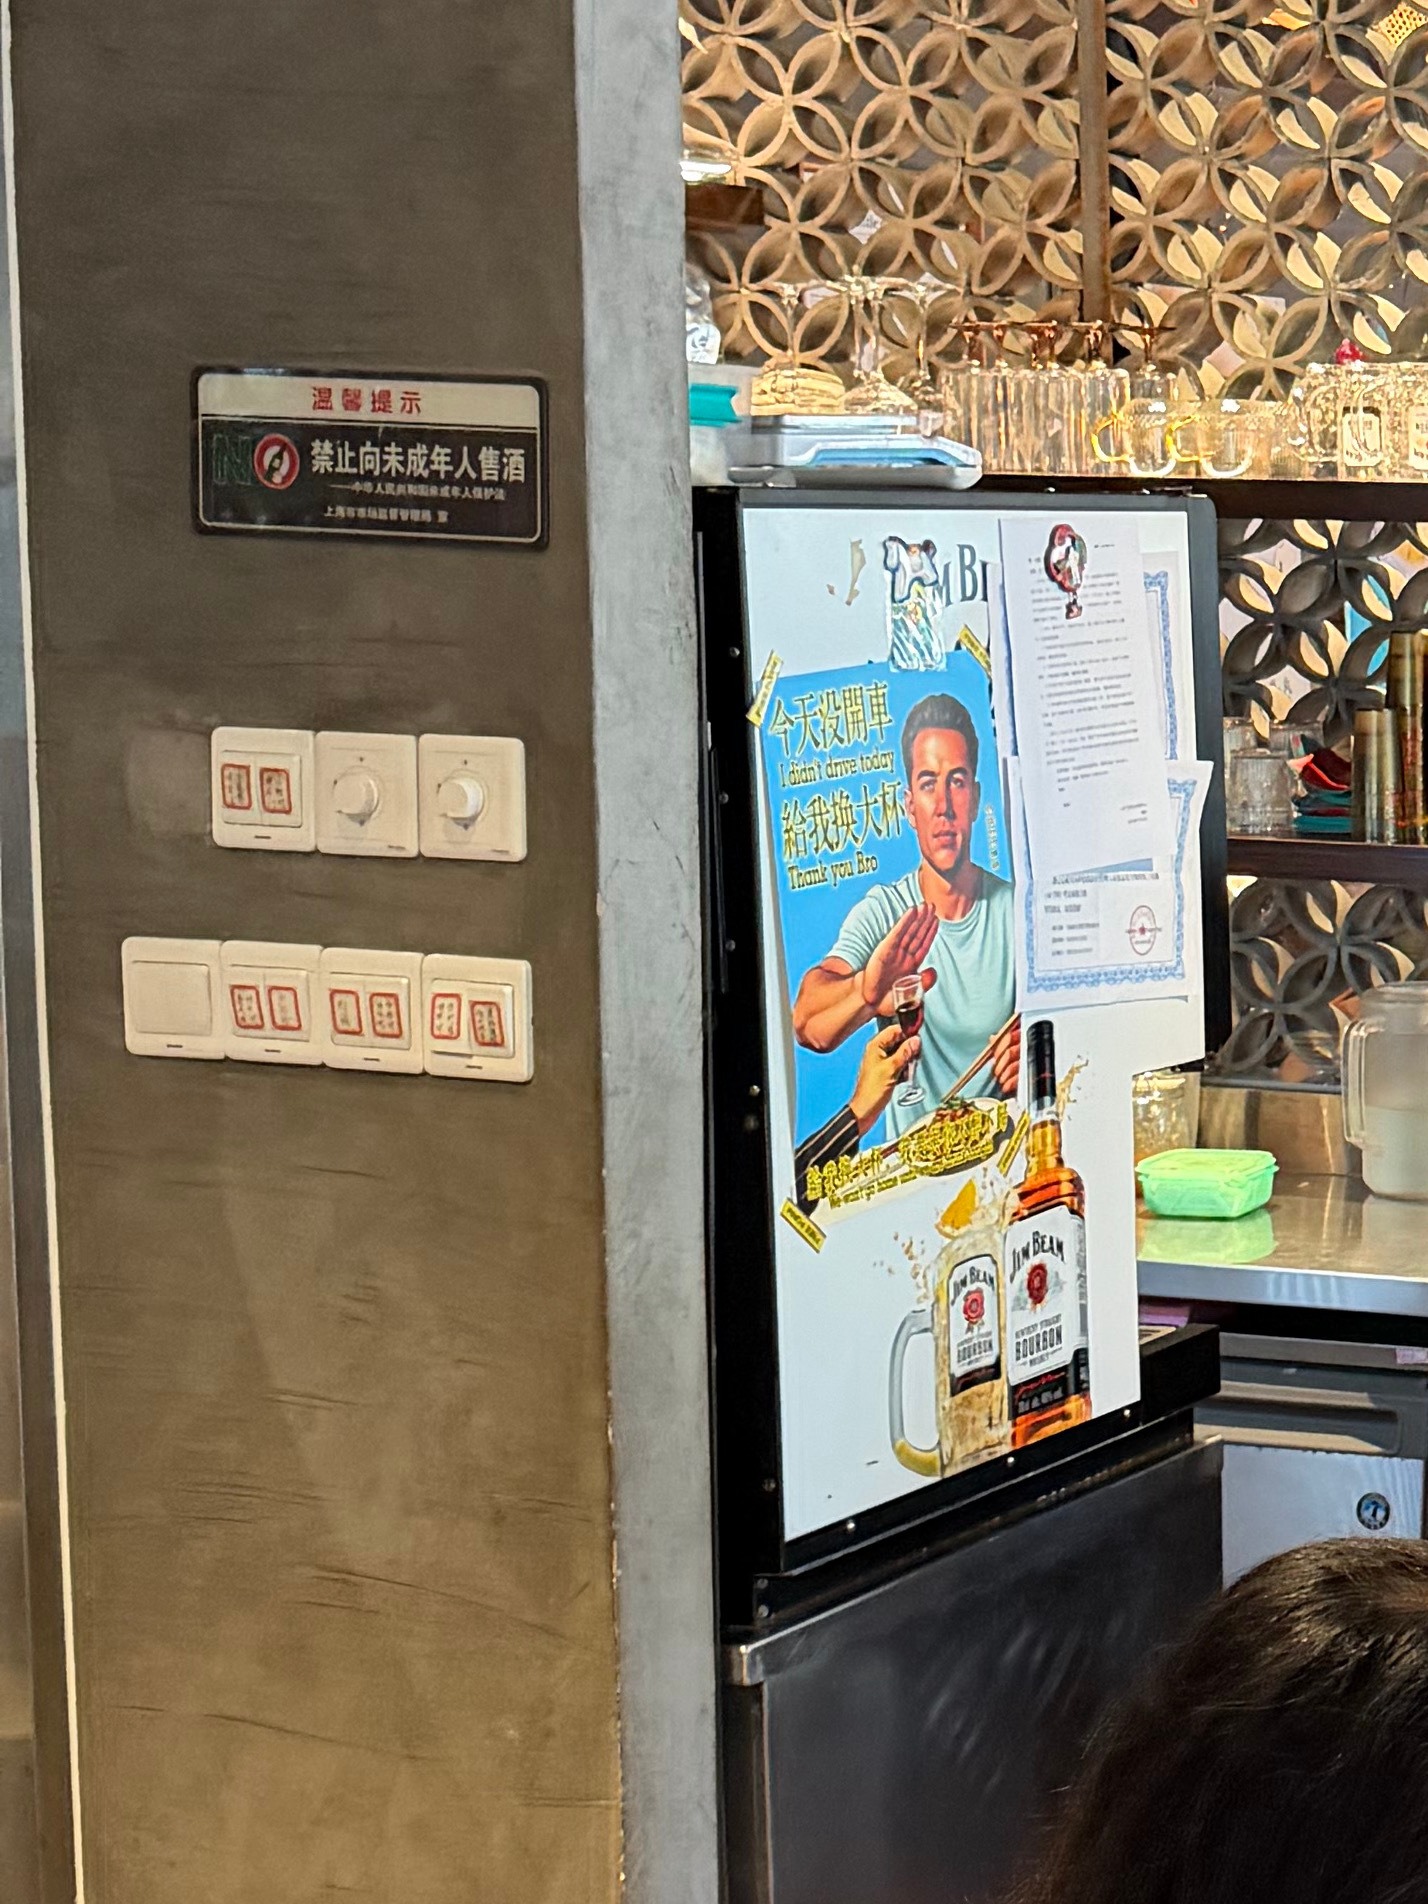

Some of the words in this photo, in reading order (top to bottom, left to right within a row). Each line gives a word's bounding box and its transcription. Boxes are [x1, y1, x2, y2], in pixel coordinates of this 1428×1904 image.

[311, 385, 423, 415] 温馨提示
[310, 437, 527, 484] 禁止向未成年人售酒
[824, 755, 858, 780] drive
[860, 748, 895, 776] today
[788, 859, 828, 891] Thank
[830, 864, 853, 887] you
[856, 850, 879, 877] Bro
[1009, 1245, 1031, 1284] JIM
[1031, 1230, 1066, 1264] BEAM
[968, 1265, 996, 1292] BEAM
[1014, 1324, 1063, 1363] BOURBON
